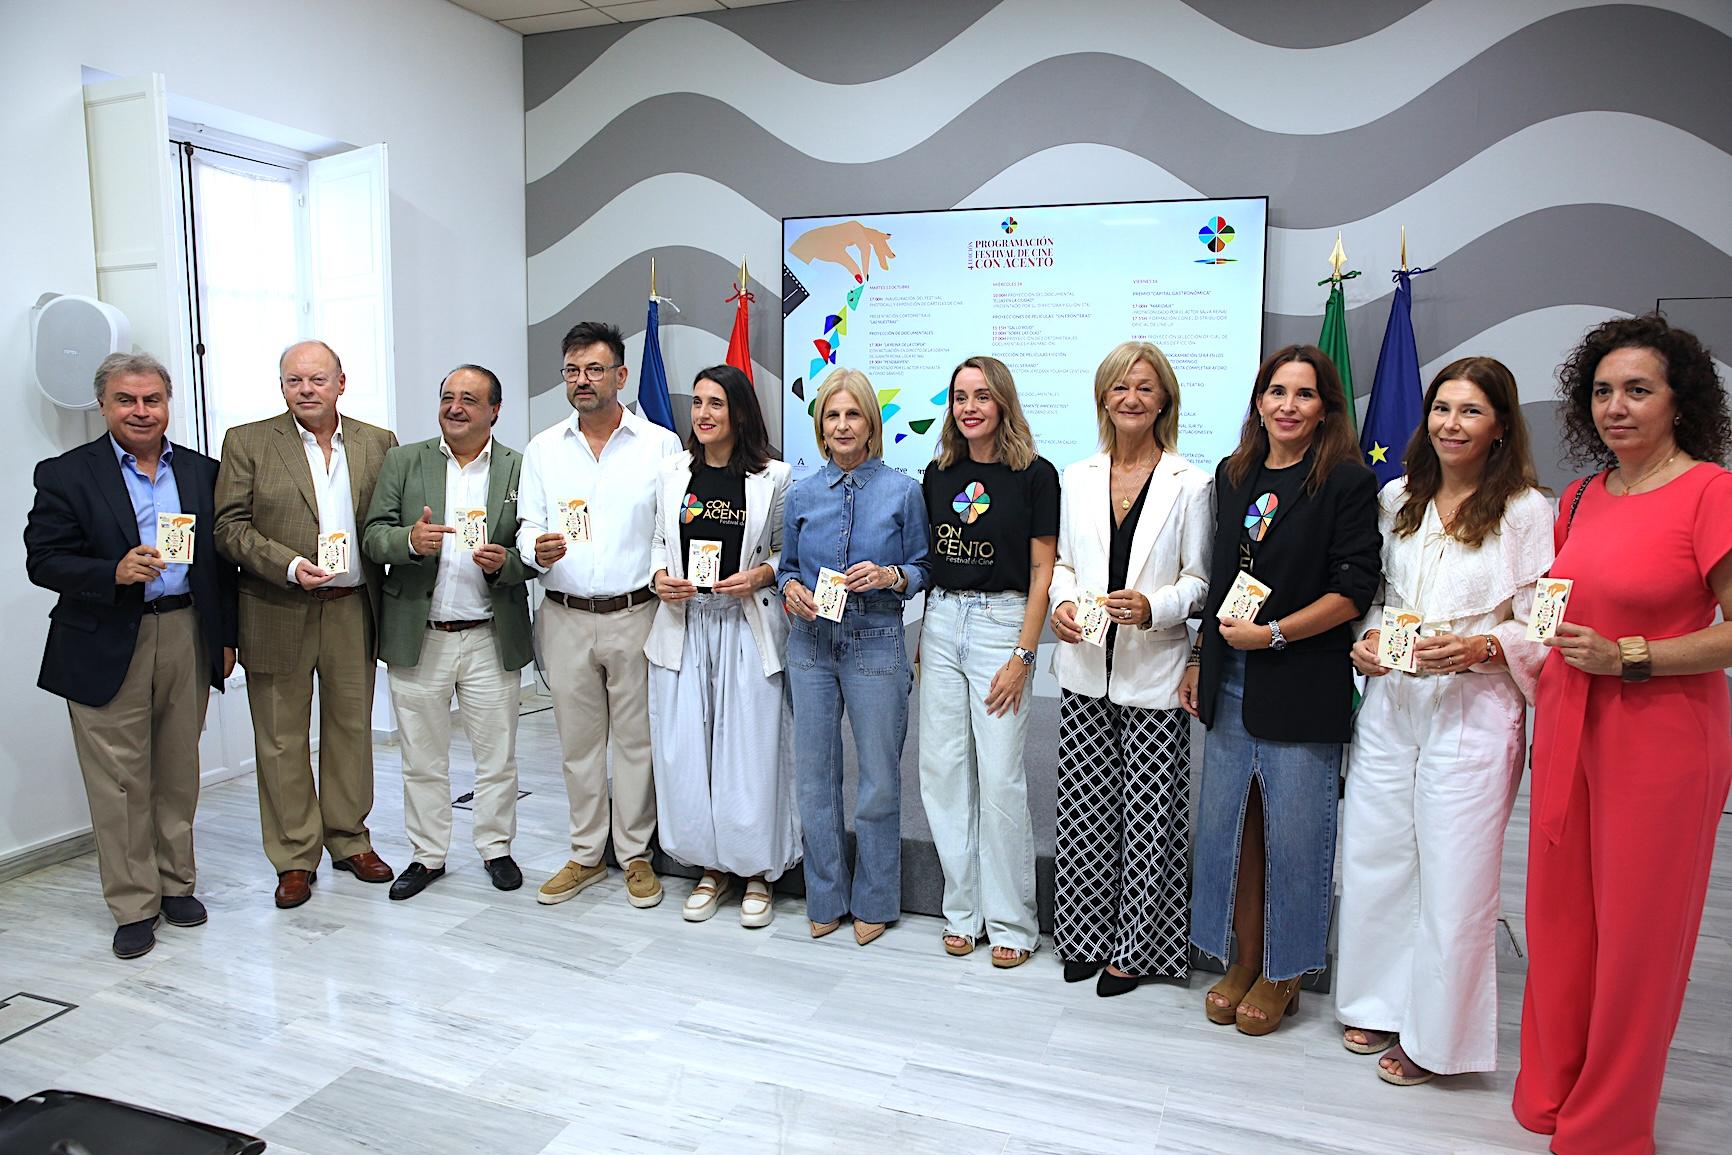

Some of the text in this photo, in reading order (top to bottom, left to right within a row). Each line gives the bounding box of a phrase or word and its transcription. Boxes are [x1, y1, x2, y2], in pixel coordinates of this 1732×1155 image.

[976, 236, 1054, 248] PROGRAMACIÓN
[976, 248, 1053, 258] FESTIVAL DE CINE
[975, 258, 1053, 268] CON ACENTO
[706, 500, 730, 508] CON
[702, 509, 746, 521] ACENT
[935, 539, 994, 558] CENTO
[946, 556, 970, 564] Festival
